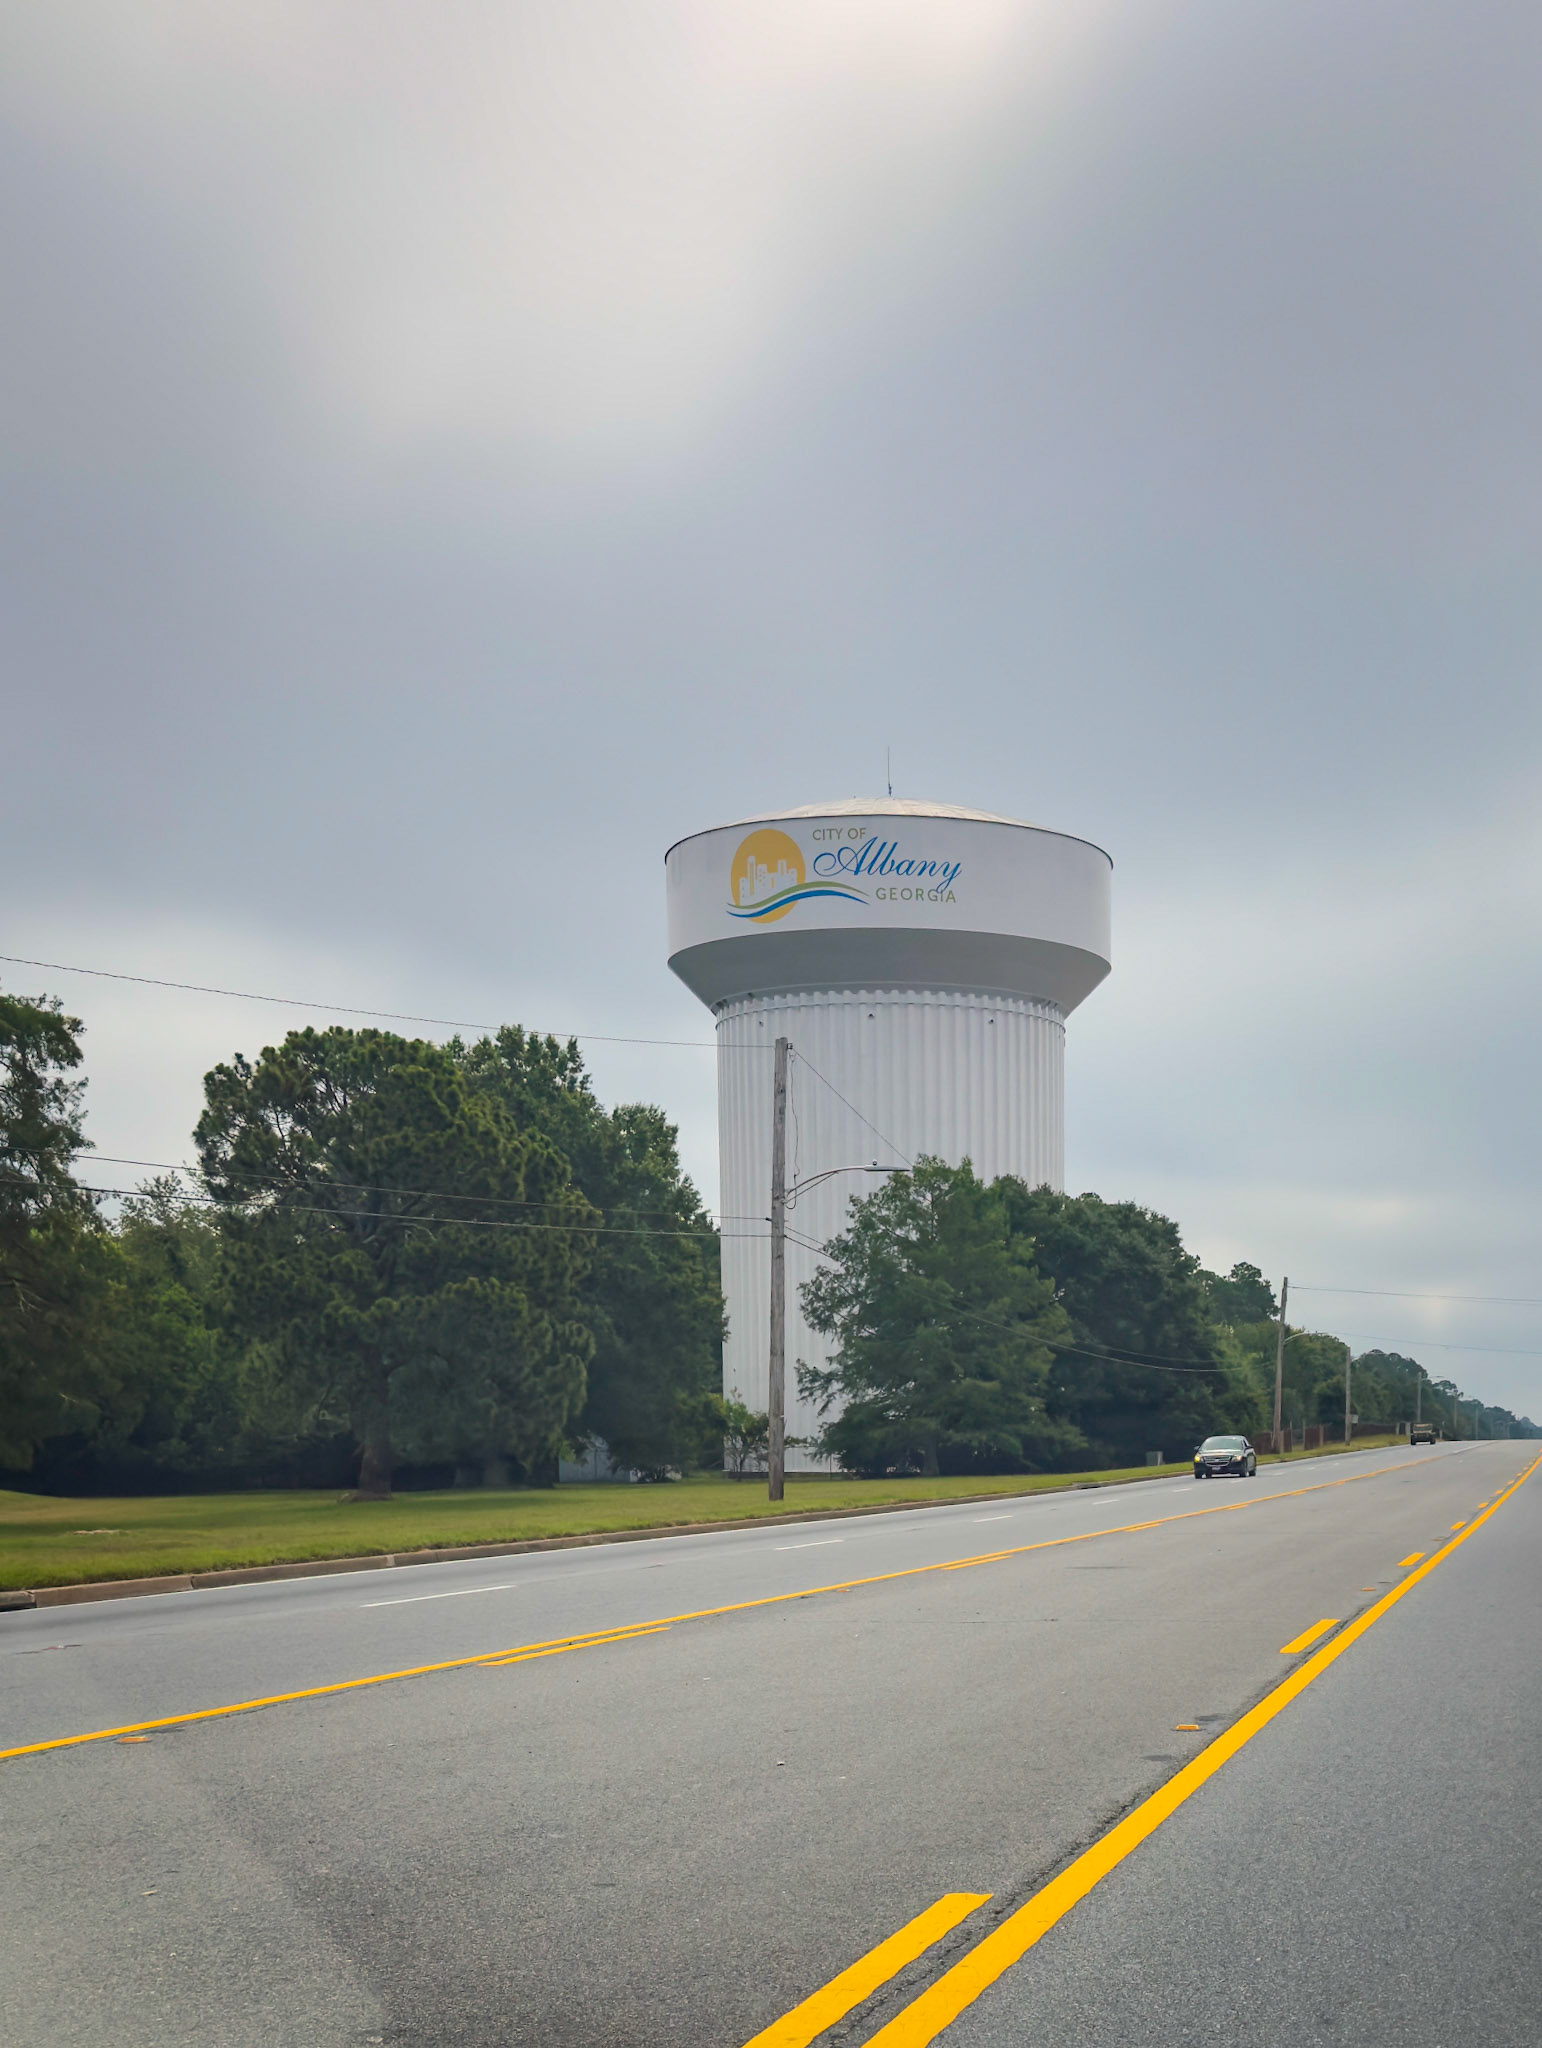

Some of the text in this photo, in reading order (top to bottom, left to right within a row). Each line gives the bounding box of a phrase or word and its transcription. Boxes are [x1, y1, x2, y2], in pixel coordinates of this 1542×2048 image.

[812, 827, 867, 841] CITY OF
[813, 836, 962, 894] Albany
[875, 887, 956, 903] GEORGIA
